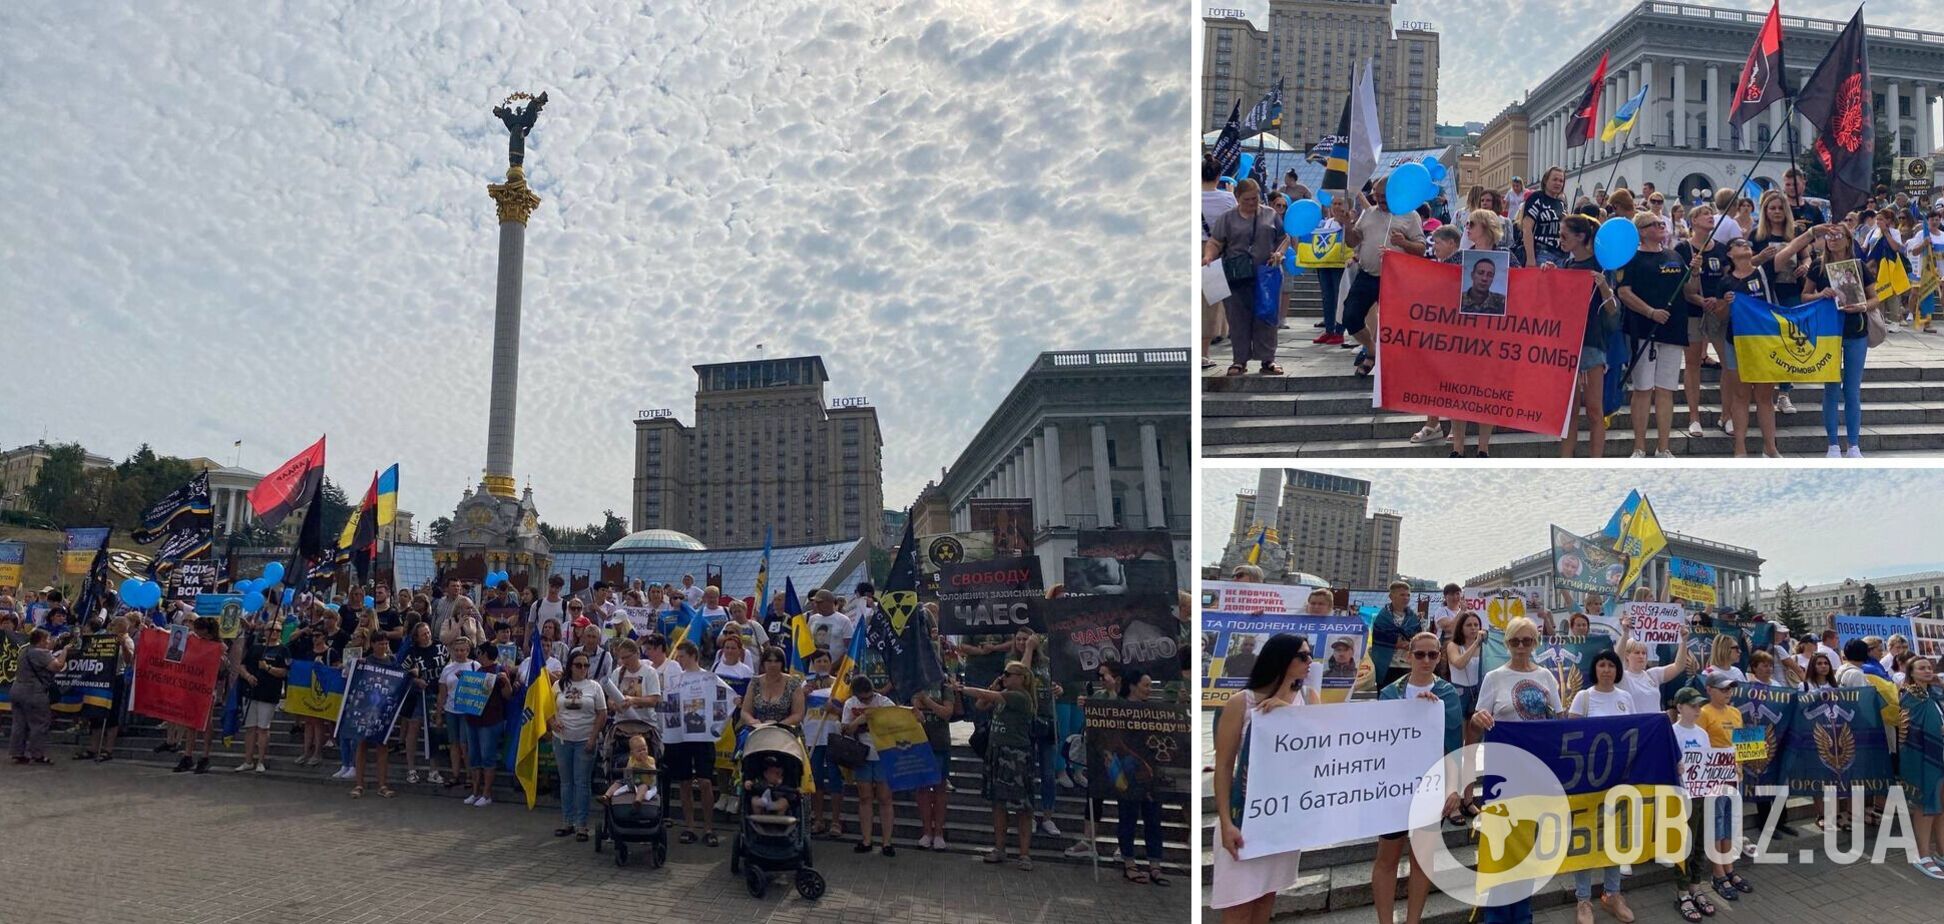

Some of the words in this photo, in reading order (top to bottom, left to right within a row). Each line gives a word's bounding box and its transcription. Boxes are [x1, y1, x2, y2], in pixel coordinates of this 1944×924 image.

[1208, 7, 1246, 18] ГОТЕЛЬ
[1402, 20, 1434, 30] HOTEL
[1410, 303, 1477, 328] ОБМІН
[1380, 327, 1494, 358] ЗАГИБЛИХ
[1499, 342, 1522, 361] 53
[1527, 345, 1579, 373] ОМБр
[1776, 358, 1817, 375] штурмова
[1816, 352, 1833, 372] рота
[1439, 381, 1514, 401] НІКОЛЬСЬКЕ
[832, 396, 870, 407] HOTEL
[1403, 392, 1514, 418] ВОЛНОВАХСЬКОГО
[1516, 408, 1543, 423] Р-НУ
[638, 408, 672, 418] ГОТЕЛЬ
[182, 564, 209, 575] ВСІХ
[183, 575, 200, 585] НА
[951, 569, 1031, 587] СВОБОДУ
[1588, 575, 1597, 584] 74
[177, 586, 203, 596] ВСІХ
[1225, 588, 1237, 596] НЕ
[1583, 582, 1598, 592] РІК
[1238, 597, 1284, 606] ІГНОРУЙТЕ
[954, 602, 1030, 626] ЧАЕС
[1206, 619, 1223, 628] ТА
[1227, 620, 1295, 631] ПОЛОНЕНІ
[1299, 622, 1315, 631] НЕ
[1319, 623, 1363, 632] ЗАБУТІ
[1636, 616, 1659, 630] 501
[1837, 622, 1888, 636] ПОВЕРНІТЬ
[1071, 624, 1122, 646] ЧАЕС
[1634, 631, 1641, 642] У
[1644, 630, 1679, 643] ПОЛОНІ
[1080, 636, 1178, 671] ВОЛЮ
[68, 659, 104, 675] ОМБр
[1085, 706, 1176, 721] НАЦГВАРДІЙЦЯМ
[1086, 718, 1125, 729] ВОЛЮ!!!
[1127, 721, 1187, 733] СВОБОДУ!!!
[1275, 733, 1331, 752] Коли
[1339, 726, 1422, 746] почнуть
[1559, 728, 1639, 790] 501
[1684, 751, 1702, 764] ТАТО
[1314, 757, 1386, 778] міняти
[1686, 765, 1700, 781] 16
[1249, 795, 1289, 819] 501
[1300, 774, 1441, 811] батальйон???
